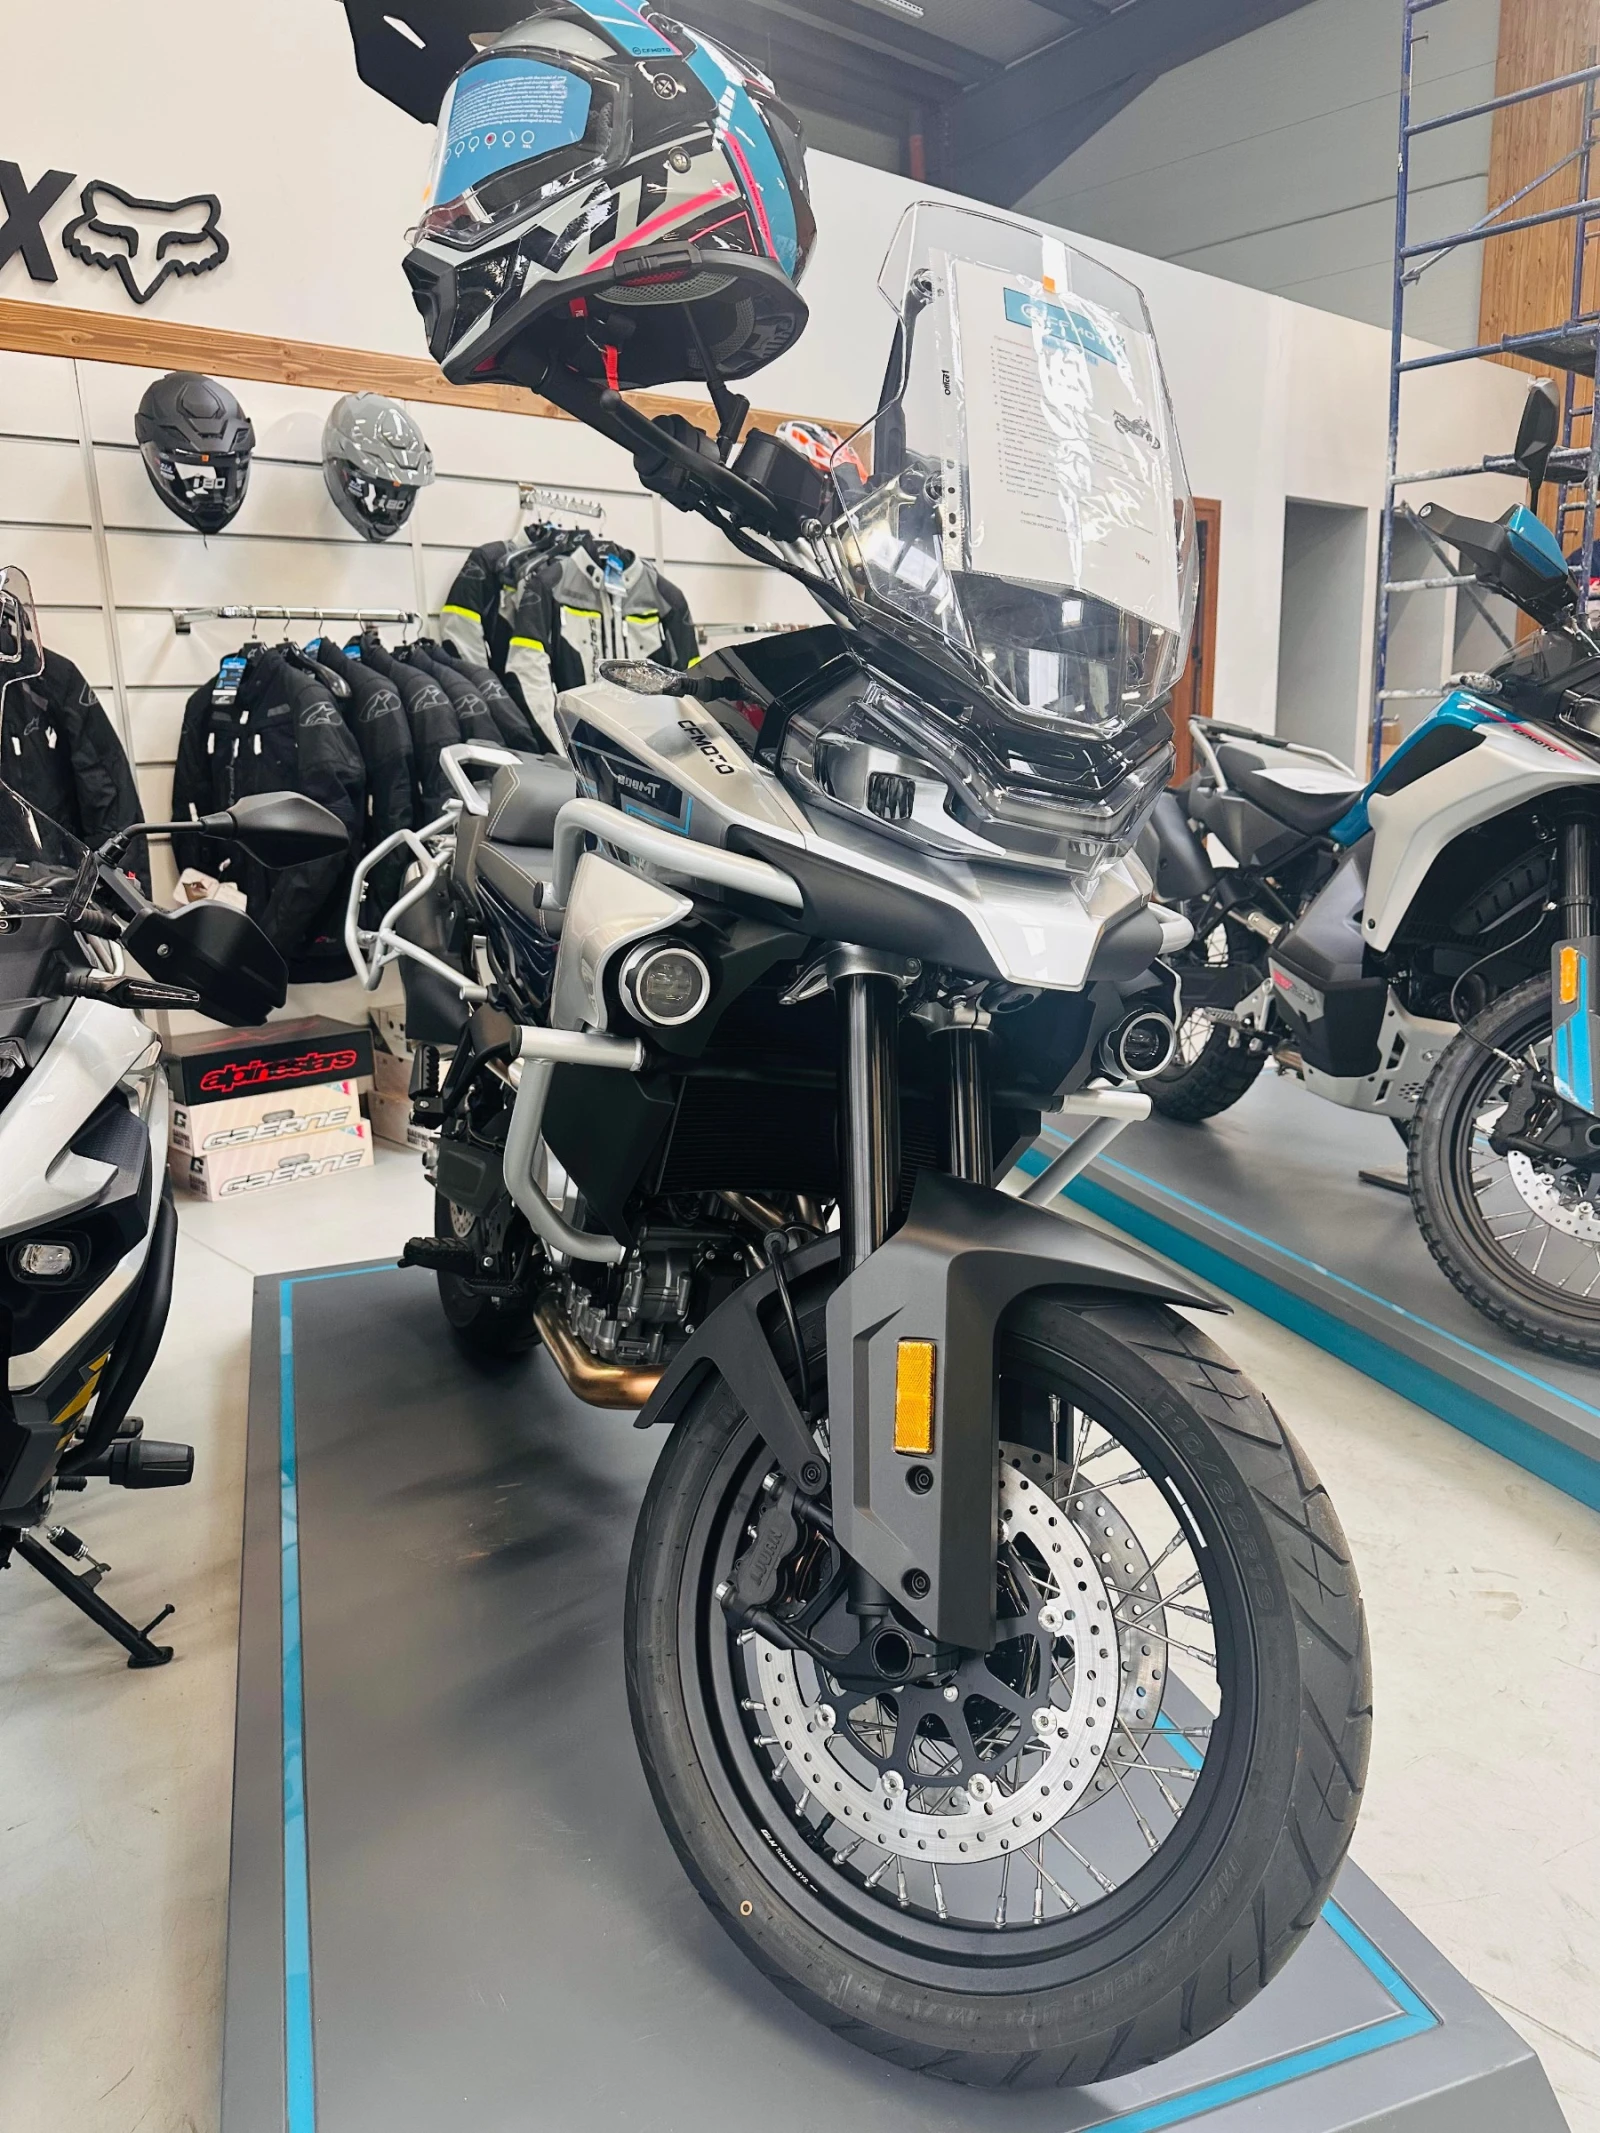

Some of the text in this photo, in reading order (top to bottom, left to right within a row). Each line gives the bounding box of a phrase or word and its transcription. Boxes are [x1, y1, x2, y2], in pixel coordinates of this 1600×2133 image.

[678, 720, 735, 774] CFMOTO
[1512, 729, 1558, 753] CFMOTO
[200, 1050, 357, 1092] alpinestars
